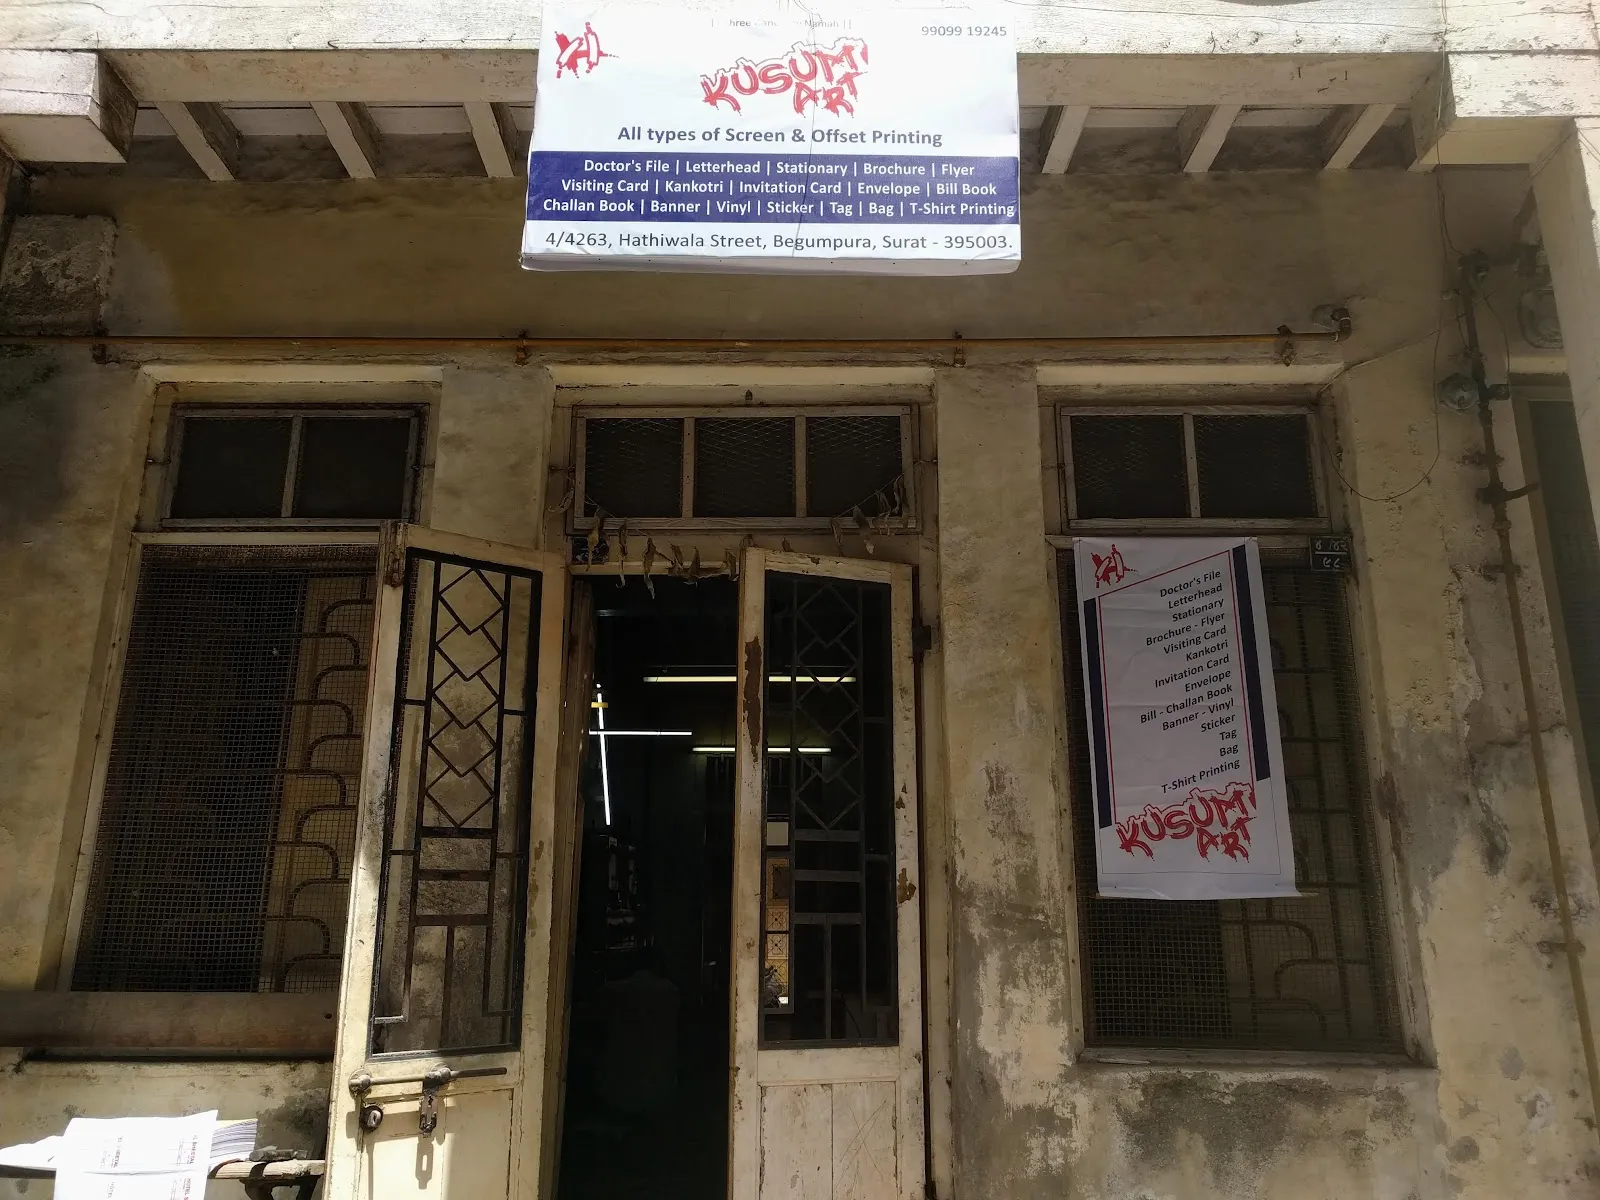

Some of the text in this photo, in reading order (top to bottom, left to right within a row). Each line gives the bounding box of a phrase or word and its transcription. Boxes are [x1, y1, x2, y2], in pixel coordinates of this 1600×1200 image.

[727, 19, 751, 28] hree
[921, 25, 1007, 36] 99099 19245
[700, 40, 868, 117] KUSUM
[792, 71, 868, 118] ART
[617, 126, 942, 147] All types of Screen & Offset Printing
[584, 159, 641, 171] Doctor's
[645, 159, 669, 172] File
[685, 160, 760, 173] Letterhead
[776, 161, 847, 176] Stationary
[863, 162, 925, 175] Brochure
[941, 163, 974, 178] Flyer
[561, 178, 613, 194] Visiting
[617, 179, 648, 192] Card
[665, 179, 723, 192] Kankotri
[739, 180, 805, 193] Invitation
[810, 181, 841, 194] Card
[858, 182, 920, 197] Envelope
[936, 182, 957, 194] Bill
[962, 183, 997, 195] Book
[543, 198, 594, 211] Challan
[599, 199, 634, 211] Book
[650, 200, 700, 212] Banner
[716, 200, 750, 215] Vinyl
[766, 200, 814, 213] Sticker
[829, 202, 852, 216] Tag
[869, 202, 894, 216] Bag
[909, 202, 956, 214] T-Shirt
[960, 203, 1016, 217] Printing
[545, 231, 612, 249] 4/4263,
[619, 232, 704, 247] Hathiwala
[710, 234, 766, 250] Street,
[773, 234, 876, 252] Begumpura,
[882, 235, 926, 248] Surat
[944, 235, 1012, 248] 395003.
[1159, 570, 1221, 597] Doctor's File
[1168, 582, 1222, 609] Letterhead
[1172, 598, 1224, 622] Stationary
[1146, 625, 1191, 646] Brochure
[1200, 612, 1225, 627] Flyer
[1163, 624, 1226, 654] Visiting Card
[1186, 639, 1228, 661] Kankotri
[1155, 653, 1229, 688] Invitation Card
[1184, 670, 1231, 692] Envelope
[1140, 709, 1156, 723] Bill
[1166, 695, 1204, 714] Challan
[1206, 683, 1232, 699] Book
[1162, 711, 1199, 731] Banner
[1207, 697, 1233, 713] Vinyl
[1200, 714, 1235, 732] Sticker
[1219, 729, 1237, 740] Tag
[1219, 744, 1238, 757] Bag
[1161, 759, 1240, 793] T-Shirt Printing
[1116, 786, 1257, 861] KUSUM
[1197, 817, 1257, 862] ART
